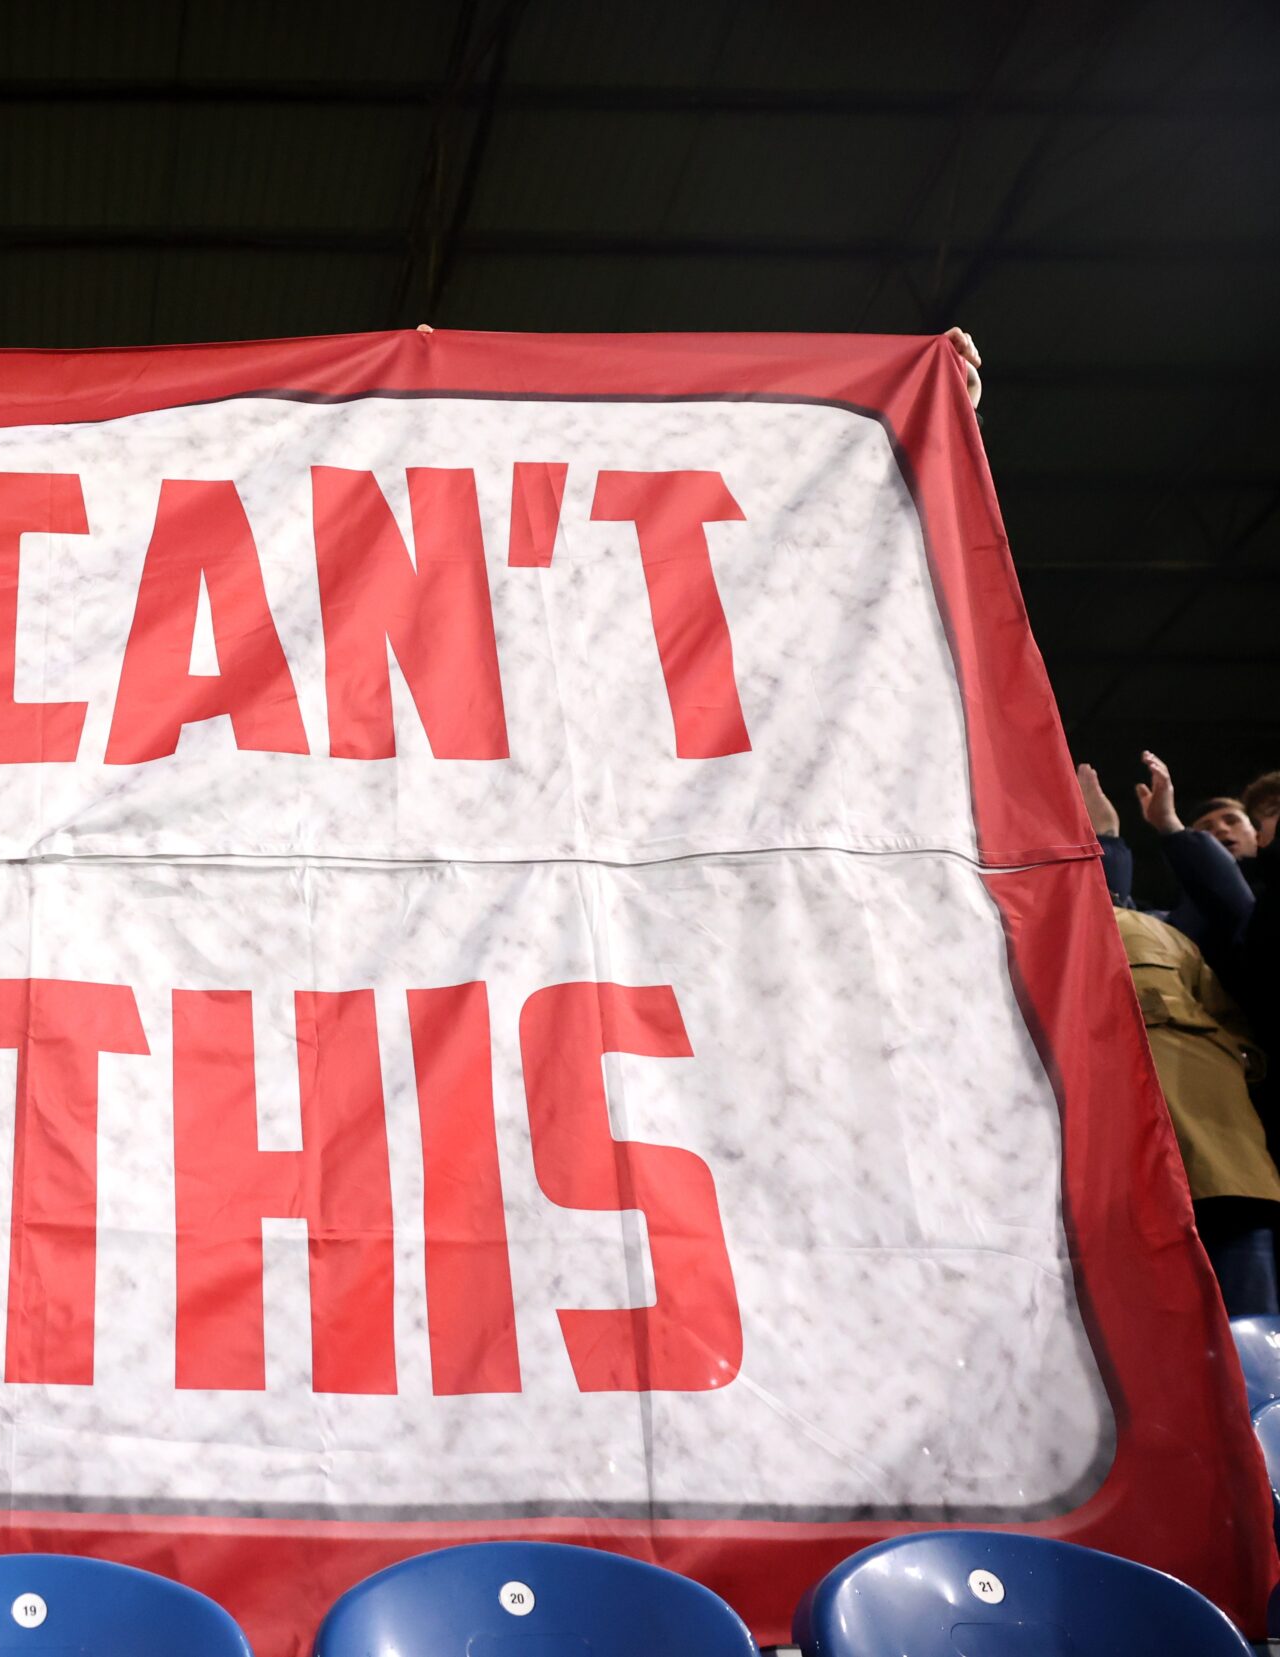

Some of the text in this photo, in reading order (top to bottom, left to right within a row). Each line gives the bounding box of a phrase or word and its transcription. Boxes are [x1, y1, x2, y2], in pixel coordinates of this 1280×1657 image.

[978, 1580, 994, 1593] 21
[510, 1592, 525, 1605] 20
[23, 1604, 38, 1617] 19
